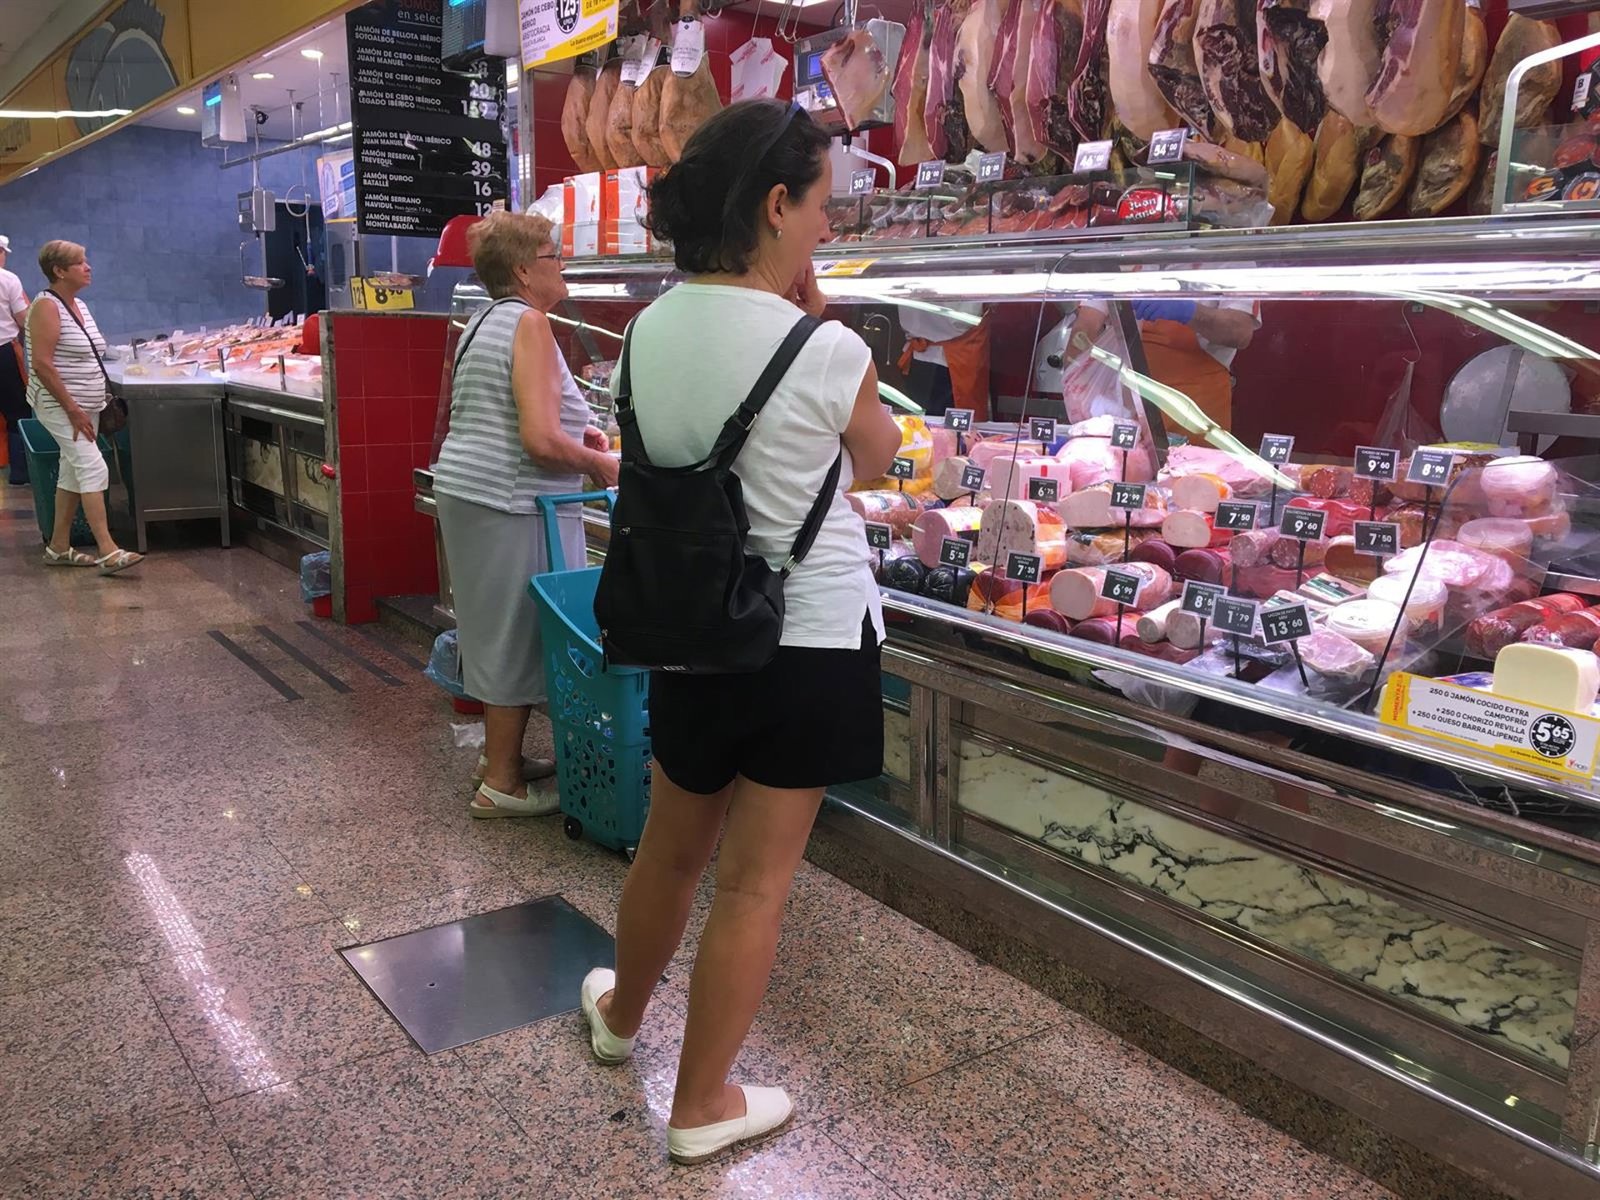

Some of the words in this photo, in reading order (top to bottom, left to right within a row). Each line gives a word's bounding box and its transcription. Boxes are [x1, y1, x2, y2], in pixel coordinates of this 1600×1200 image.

[398, 10, 411, 20] en
[355, 25, 381, 35] JAMÓN
[392, 30, 419, 40] BELLOTA
[357, 46, 382, 57] JAMÓN
[383, 50, 393, 58] DE
[394, 51, 413, 60] CEBO
[414, 53, 441, 64] IBÉRICO
[357, 54, 376, 63] JUAN
[376, 57, 405, 67] MANUEL
[358, 68, 383, 79] JAMÓN
[384, 71, 394, 79] DE
[395, 73, 414, 82] CEBO
[415, 74, 441, 86] IBÉRICO
[1578, 78, 1584, 88] B
[359, 90, 384, 99] JAMÓN
[396, 93, 414, 102] CEBO
[415, 94, 441, 105] IBÉRICO
[359, 97, 386, 106] LEGADO
[388, 98, 415, 109] IBÉRICO
[362, 130, 388, 139] JAMÓN
[425, 135, 452, 145] IBÉRICO
[380, 139, 403, 147] MANUEL
[361, 148, 386, 157] JAMÓN
[388, 152, 415, 161] RESERVA
[472, 160, 491, 176] 39
[981, 164, 1000, 177] 18'00
[363, 171, 388, 180] JAMÓN
[389, 174, 414, 183] DUROC
[921, 170, 939, 181] 18'00
[473, 181, 492, 197] 16
[365, 193, 389, 202] JAMÓN
[391, 195, 421, 205] SERRANO
[365, 200, 393, 209] NAVIDUL
[366, 213, 391, 222] JAMÓN
[952, 418, 968, 427] 8'95
[1037, 427, 1051, 437] 7'90
[1368, 460, 1390, 472] 9'60
[1422, 463, 1445, 476] 8'90
[1038, 487, 1054, 497] 6'75
[1116, 492, 1140, 503] 12'99
[1229, 512, 1250, 524] 7'50
[1295, 520, 1318, 532] 9'60
[1369, 533, 1392, 545] 7'50
[949, 550, 965, 561] 5'25
[1017, 565, 1035, 576] 7'30
[1113, 584, 1133, 596] 6'99
[1194, 595, 1213, 609] 8'5
[1227, 610, 1250, 624] 1'79
[1269, 619, 1303, 637] 13'60
[1429, 687, 1443, 696] 250
[1450, 691, 1476, 704] JAMÓN
[1476, 699, 1504, 711] COCIDO
[1504, 706, 1530, 718] EXTRA
[1441, 707, 1455, 717] 250
[1462, 713, 1494, 727] CHORIZO
[1494, 721, 1526, 735] REVILLA
[1484, 710, 1528, 726] CAMPOFRÍO
[1417, 710, 1431, 719] 250
[1437, 716, 1461, 727] QUESO
[1462, 721, 1486, 734] BARRA
[1486, 729, 1524, 744] ALIPENDE
[1536, 721, 1570, 743] 5'65
